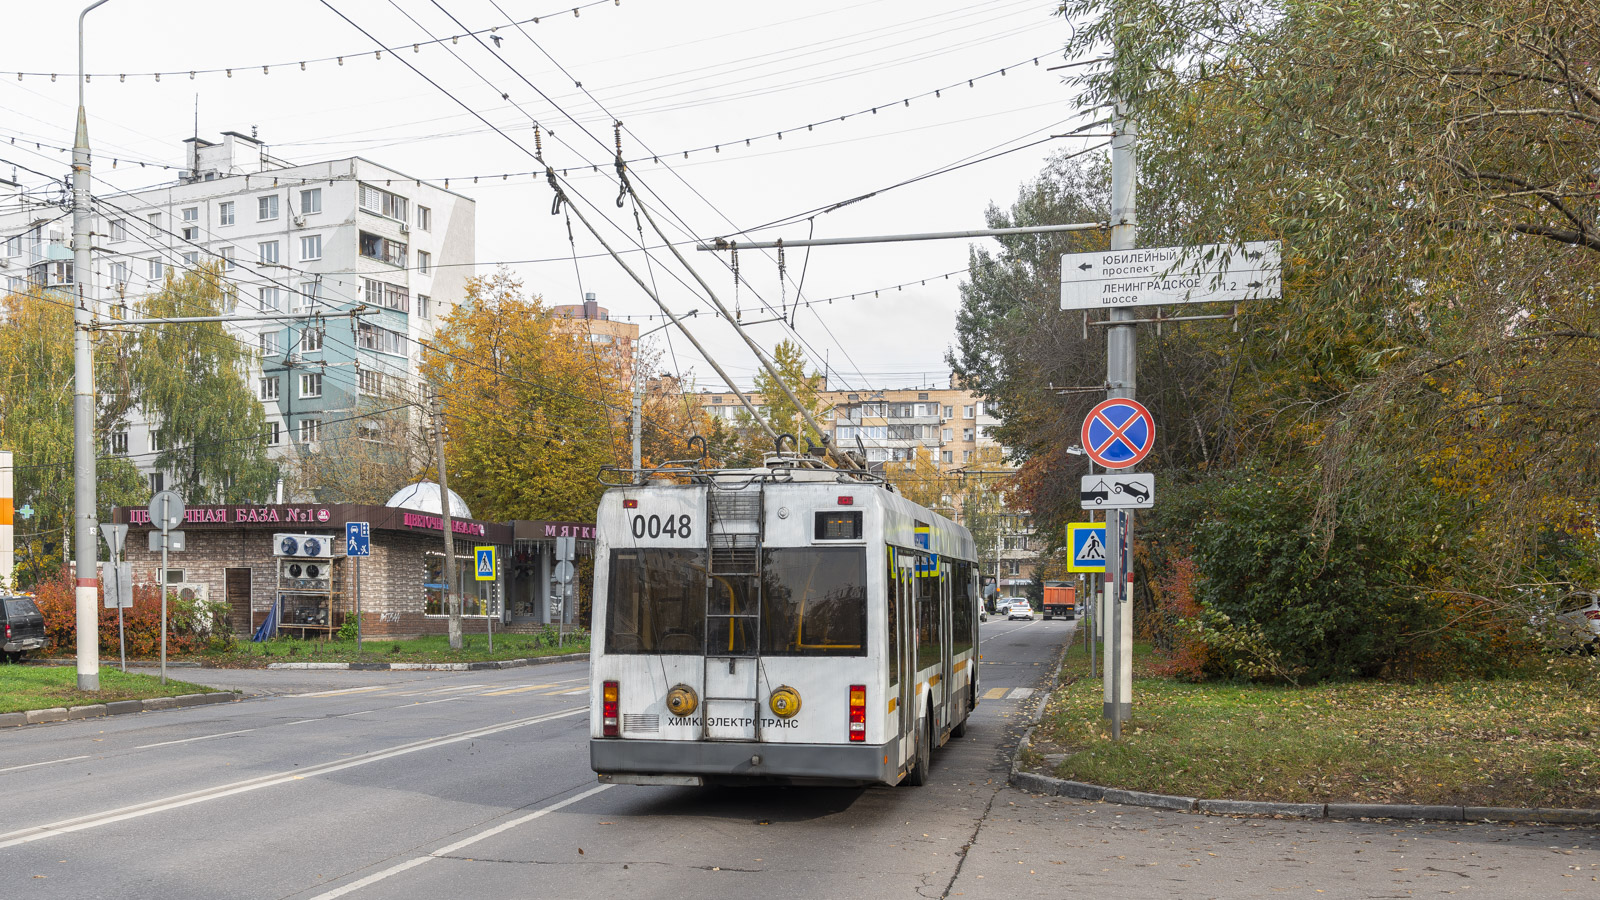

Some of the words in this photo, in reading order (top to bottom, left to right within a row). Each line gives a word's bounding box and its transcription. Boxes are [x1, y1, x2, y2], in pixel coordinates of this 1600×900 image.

[1102, 249, 1178, 265] ЮБИЛЕЙНЫЙ
[1102, 265, 1156, 277] проспект
[1102, 279, 1201, 294] ЛЕНИНГРАДСКОЕ
[1102, 295, 1138, 304] шоссе
[130, 509, 227, 525] ЦВЧНАЯ
[236, 508, 279, 522] БАЗА
[286, 508, 314, 522] №1
[632, 514, 692, 539] 0048
